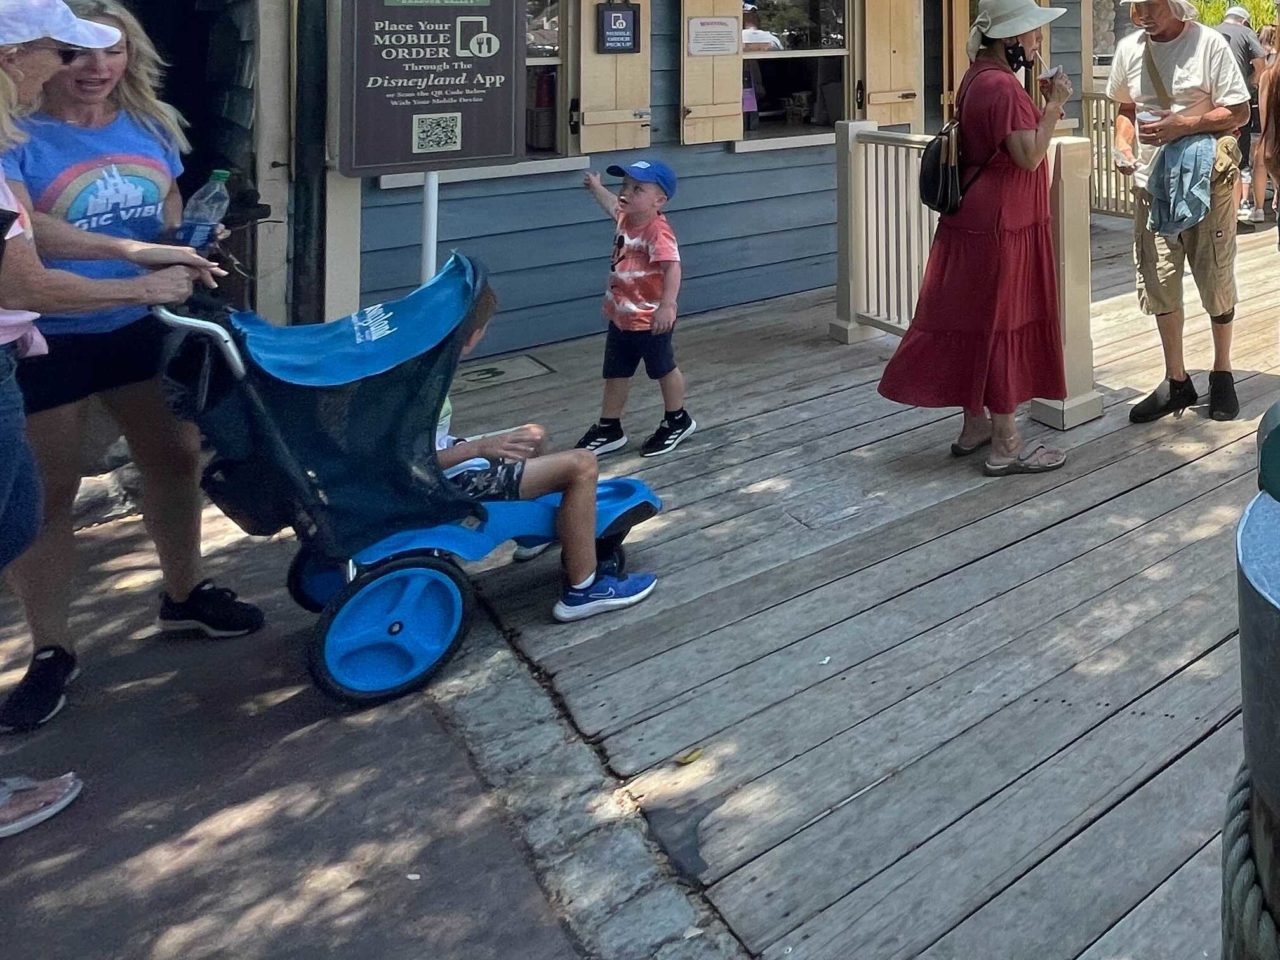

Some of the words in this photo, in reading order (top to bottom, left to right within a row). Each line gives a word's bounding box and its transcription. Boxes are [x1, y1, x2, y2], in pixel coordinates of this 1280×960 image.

[374, 21, 414, 31] Place
[418, 21, 452, 31] Your
[373, 34, 452, 46] MOBILE
[381, 47, 451, 59] ORDER
[402, 63, 450, 72] Through
[452, 61, 473, 70] The
[366, 72, 467, 89] Disneyland
[473, 73, 505, 87] App
[73, 213, 114, 230] GIC
